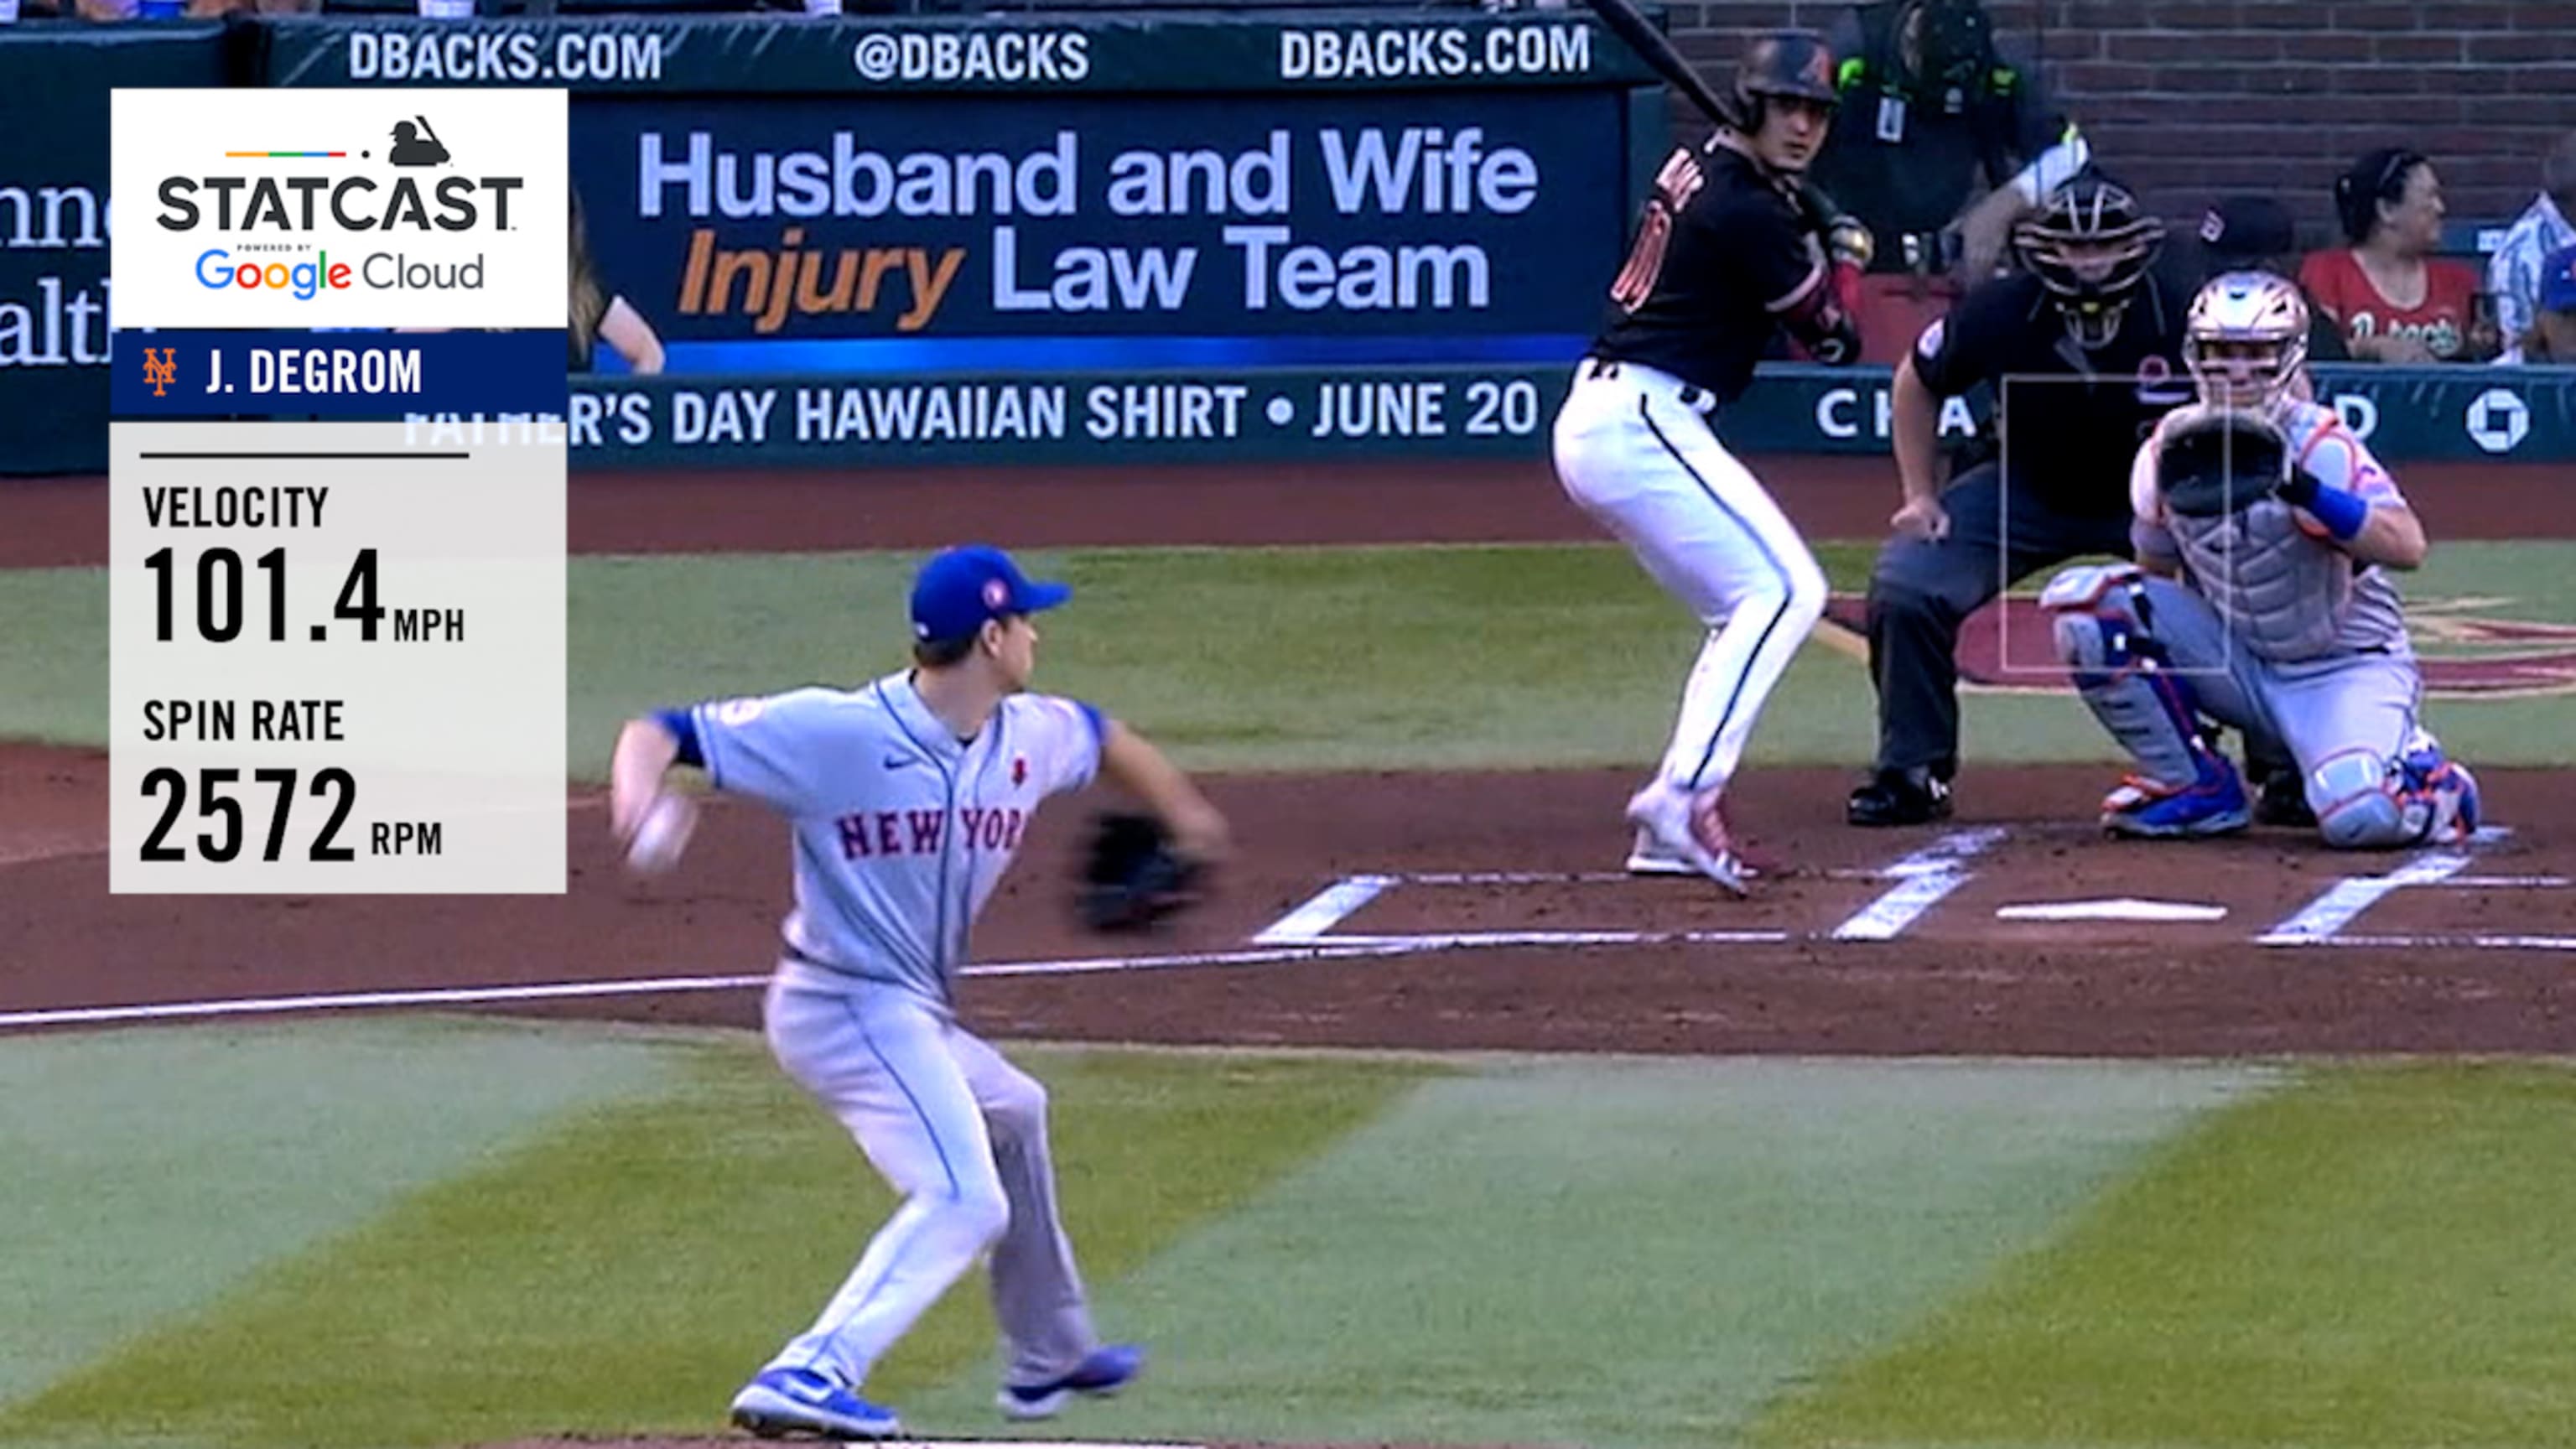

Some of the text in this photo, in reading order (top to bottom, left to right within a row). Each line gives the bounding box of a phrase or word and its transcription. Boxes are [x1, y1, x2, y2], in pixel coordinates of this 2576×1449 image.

[350, 34, 661, 80] DBACKS.COM
[854, 34, 1089, 80] @DBACKS
[1281, 26, 1590, 79] DBACKS.COM
[639, 127, 1539, 216] Husband and Wife
[678, 225, 1490, 333] Injury Law Team
[673, 389, 776, 444] DAY
[797, 386, 1066, 441] HAWAIIAN
[1086, 386, 1248, 439] SHIRT
[1312, 383, 1446, 436] JUNE
[1465, 382, 1539, 435] 20
[835, 809, 944, 860] NEW
